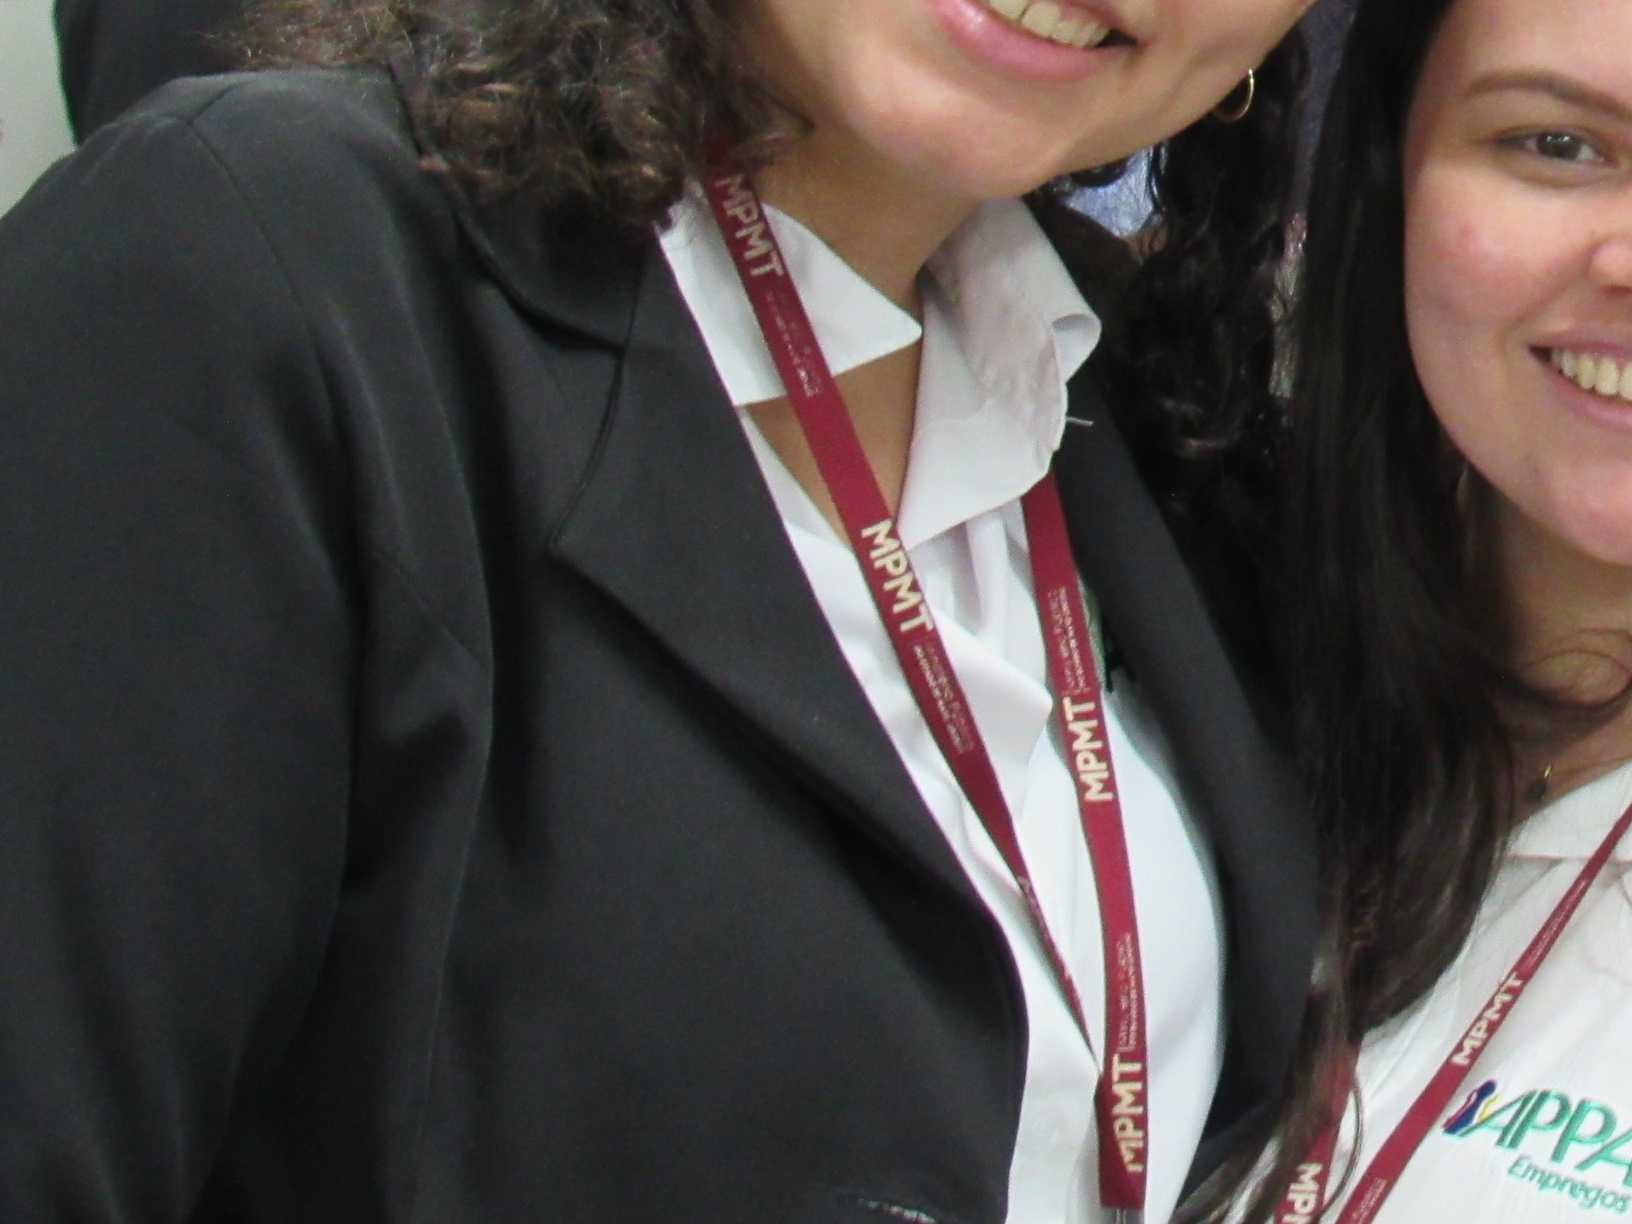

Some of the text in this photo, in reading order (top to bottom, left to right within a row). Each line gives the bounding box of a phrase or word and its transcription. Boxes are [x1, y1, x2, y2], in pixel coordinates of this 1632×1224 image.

[714, 174, 784, 276] MPMT
[862, 519, 933, 634] MPMT
[1062, 696, 1115, 802] MPMT
[1452, 971, 1524, 1065] MPMT
[1111, 1053, 1144, 1173] MPMT
[1507, 1155, 1632, 1215] Empregos
